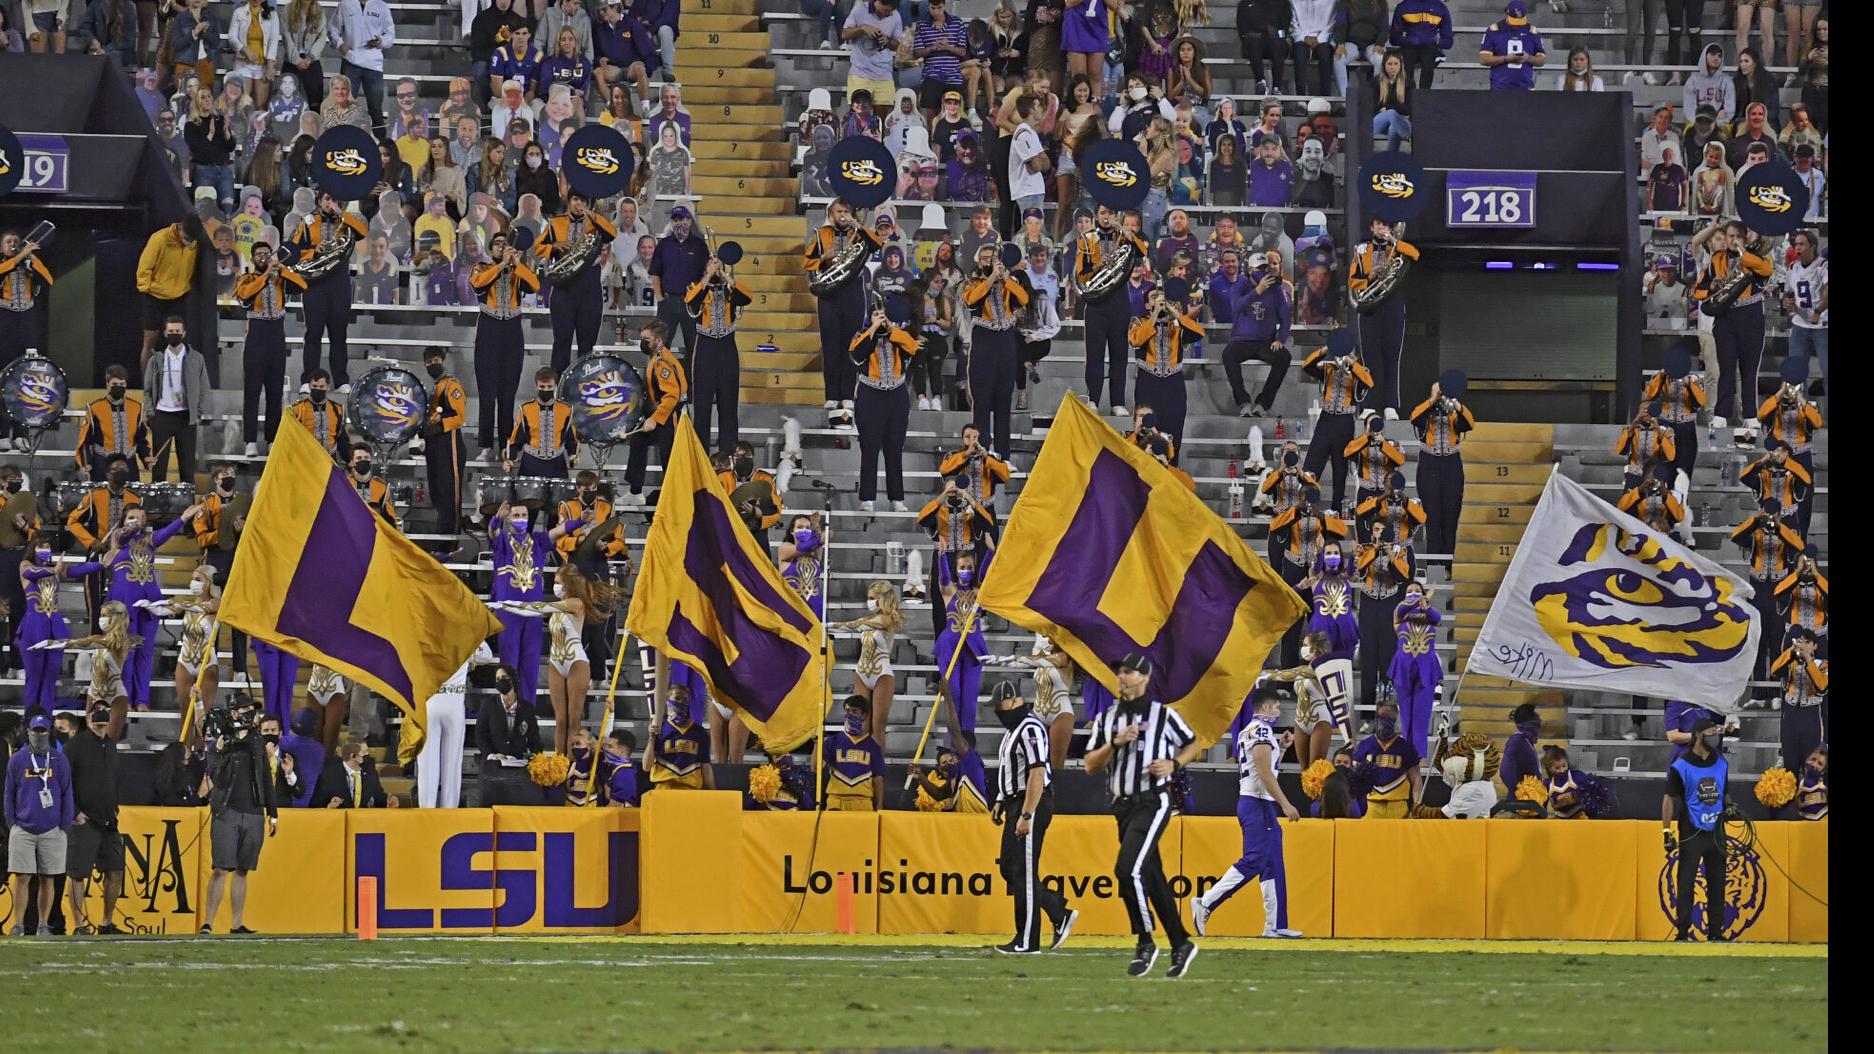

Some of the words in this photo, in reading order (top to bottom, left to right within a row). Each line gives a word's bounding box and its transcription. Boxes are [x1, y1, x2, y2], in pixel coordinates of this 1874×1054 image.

[701, 0, 712, 9] 11
[708, 33, 720, 45] 10
[717, 69, 725, 79] 9
[723, 105, 731, 117] 8
[731, 142, 738, 153] 7
[18, 155, 55, 187] 19
[738, 179, 745, 190] 6
[1460, 190, 1521, 223] 218
[745, 218, 753, 229] 5
[752, 256, 760, 267] 4
[760, 294, 767, 305] 3
[1796, 280, 1813, 309] 9
[767, 334, 775, 345] 2
[774, 374, 781, 385] 1
[1496, 466, 1509, 477] 13
[1497, 507, 1510, 518] 12
[1498, 546, 1510, 556] 11
[1254, 727, 1269, 739] 42
[664, 738, 699, 755] LSU
[835, 748, 871, 766] LSU
[24, 768, 54, 779] LU
[354, 831, 640, 928] LSU
[123, 917, 167, 935] Soul
